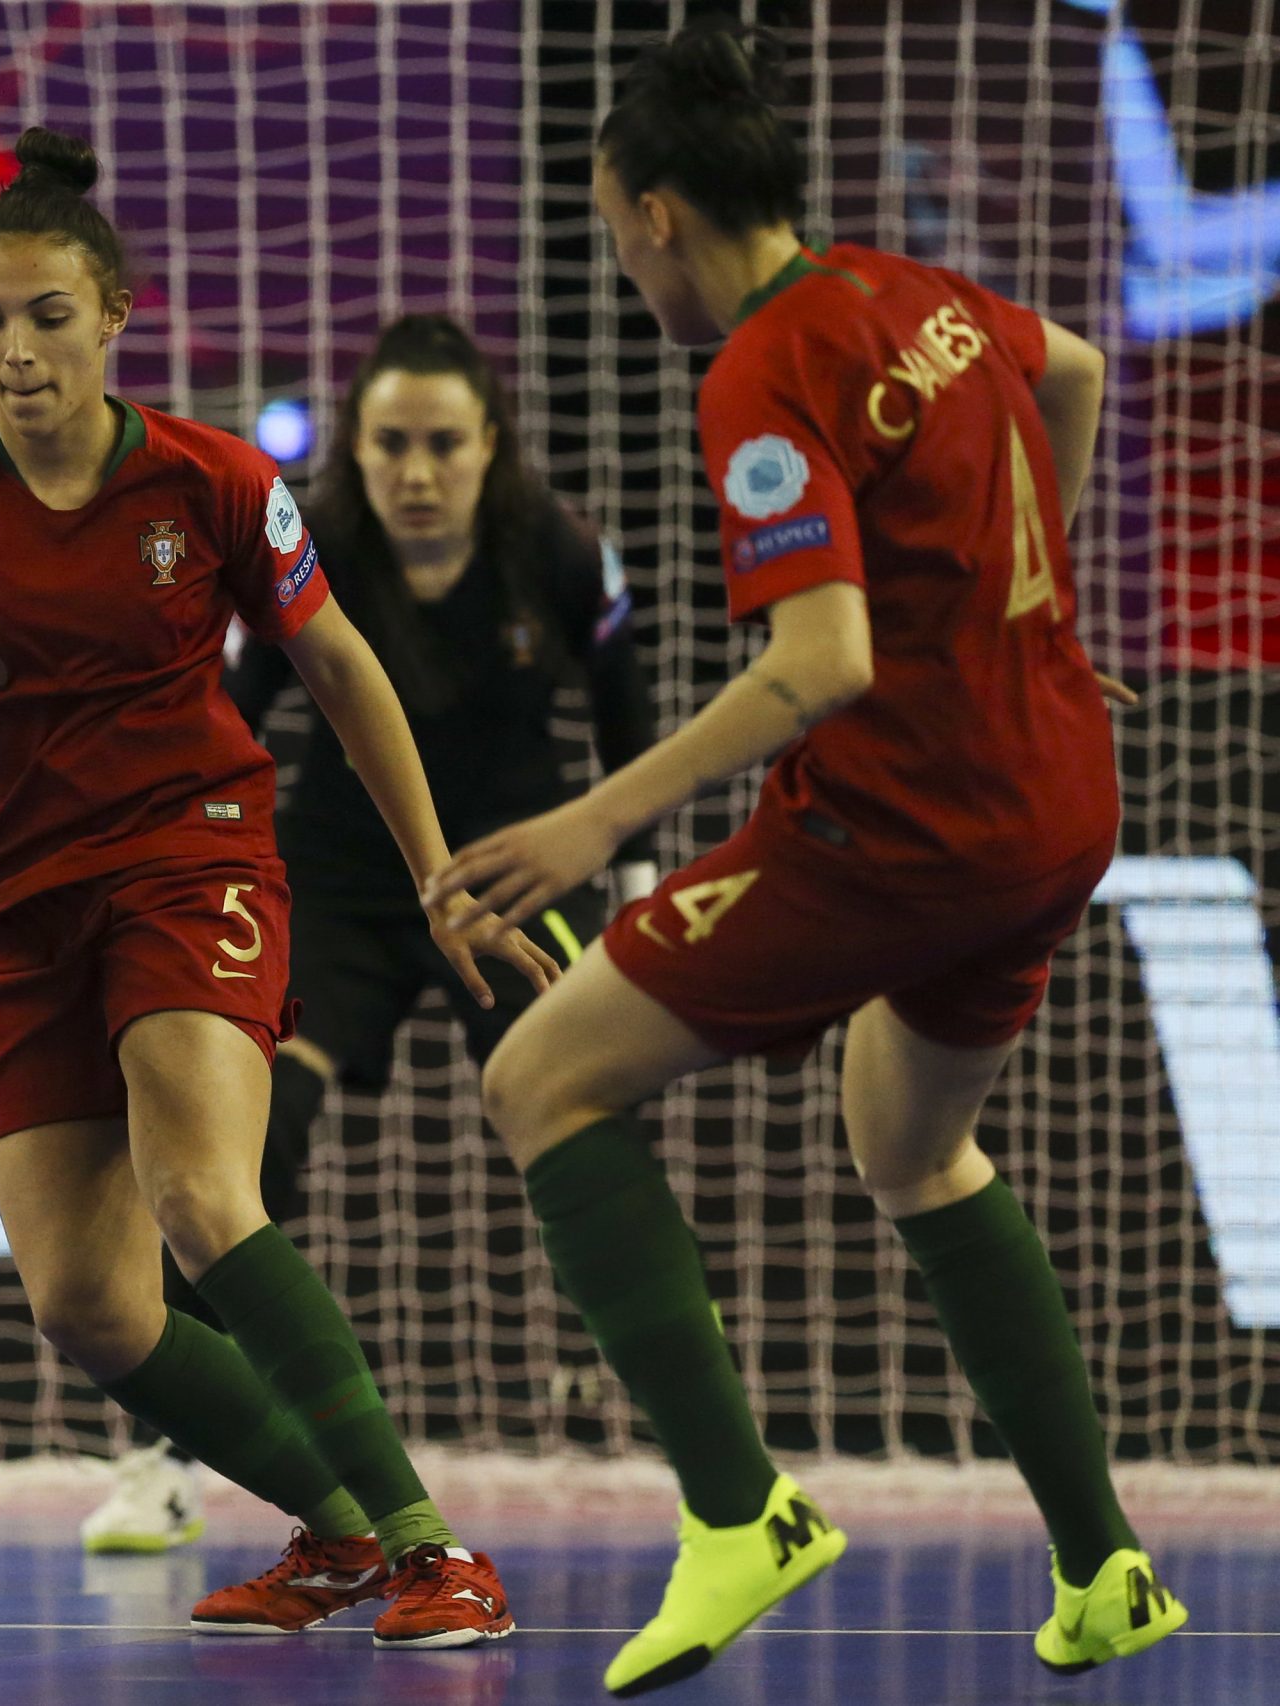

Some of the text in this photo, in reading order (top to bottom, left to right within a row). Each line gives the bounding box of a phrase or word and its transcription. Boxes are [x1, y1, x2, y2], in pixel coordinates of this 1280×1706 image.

[867, 381, 915, 439] C
[1005, 412, 1062, 622] 4
[216, 883, 262, 963] 5
[670, 868, 761, 944] 4
